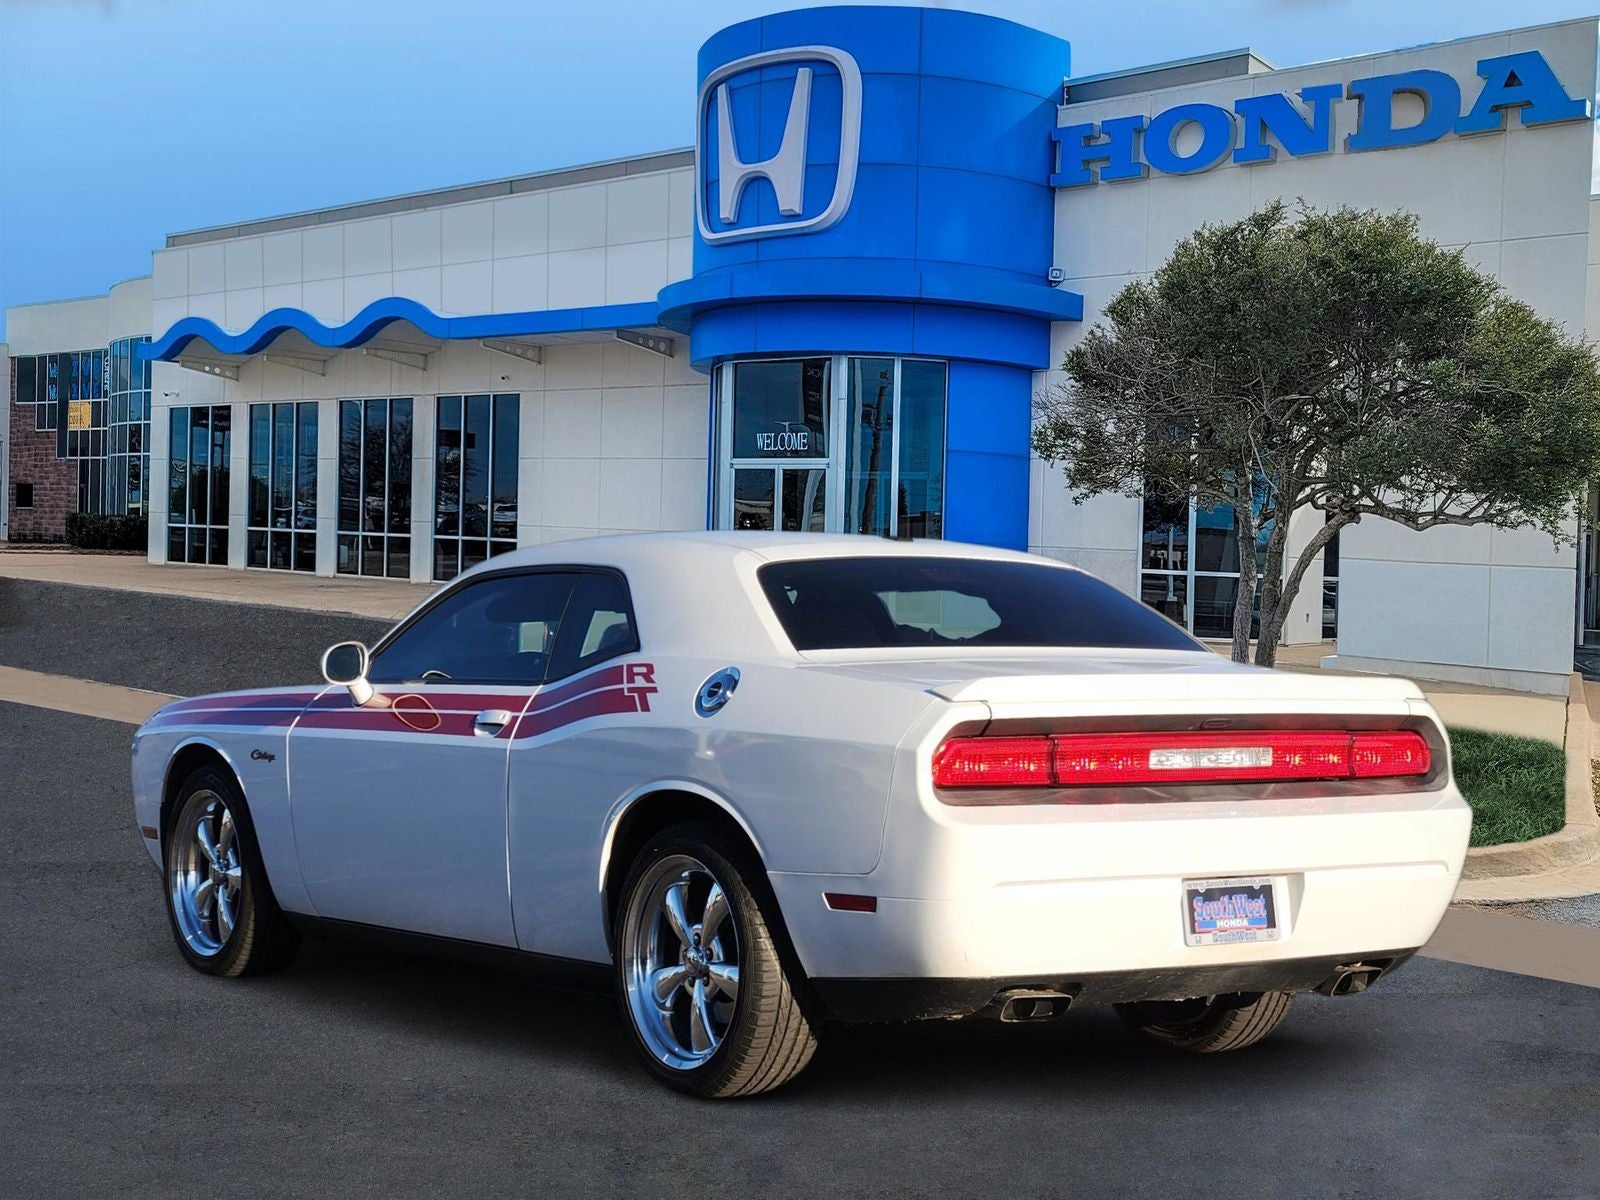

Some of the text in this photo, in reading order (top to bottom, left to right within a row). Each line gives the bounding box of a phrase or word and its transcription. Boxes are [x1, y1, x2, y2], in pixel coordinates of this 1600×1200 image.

[1051, 50, 1592, 188] HONDA
[756, 432, 808, 451] WELCOME
[1217, 919, 1249, 928] HONDA
